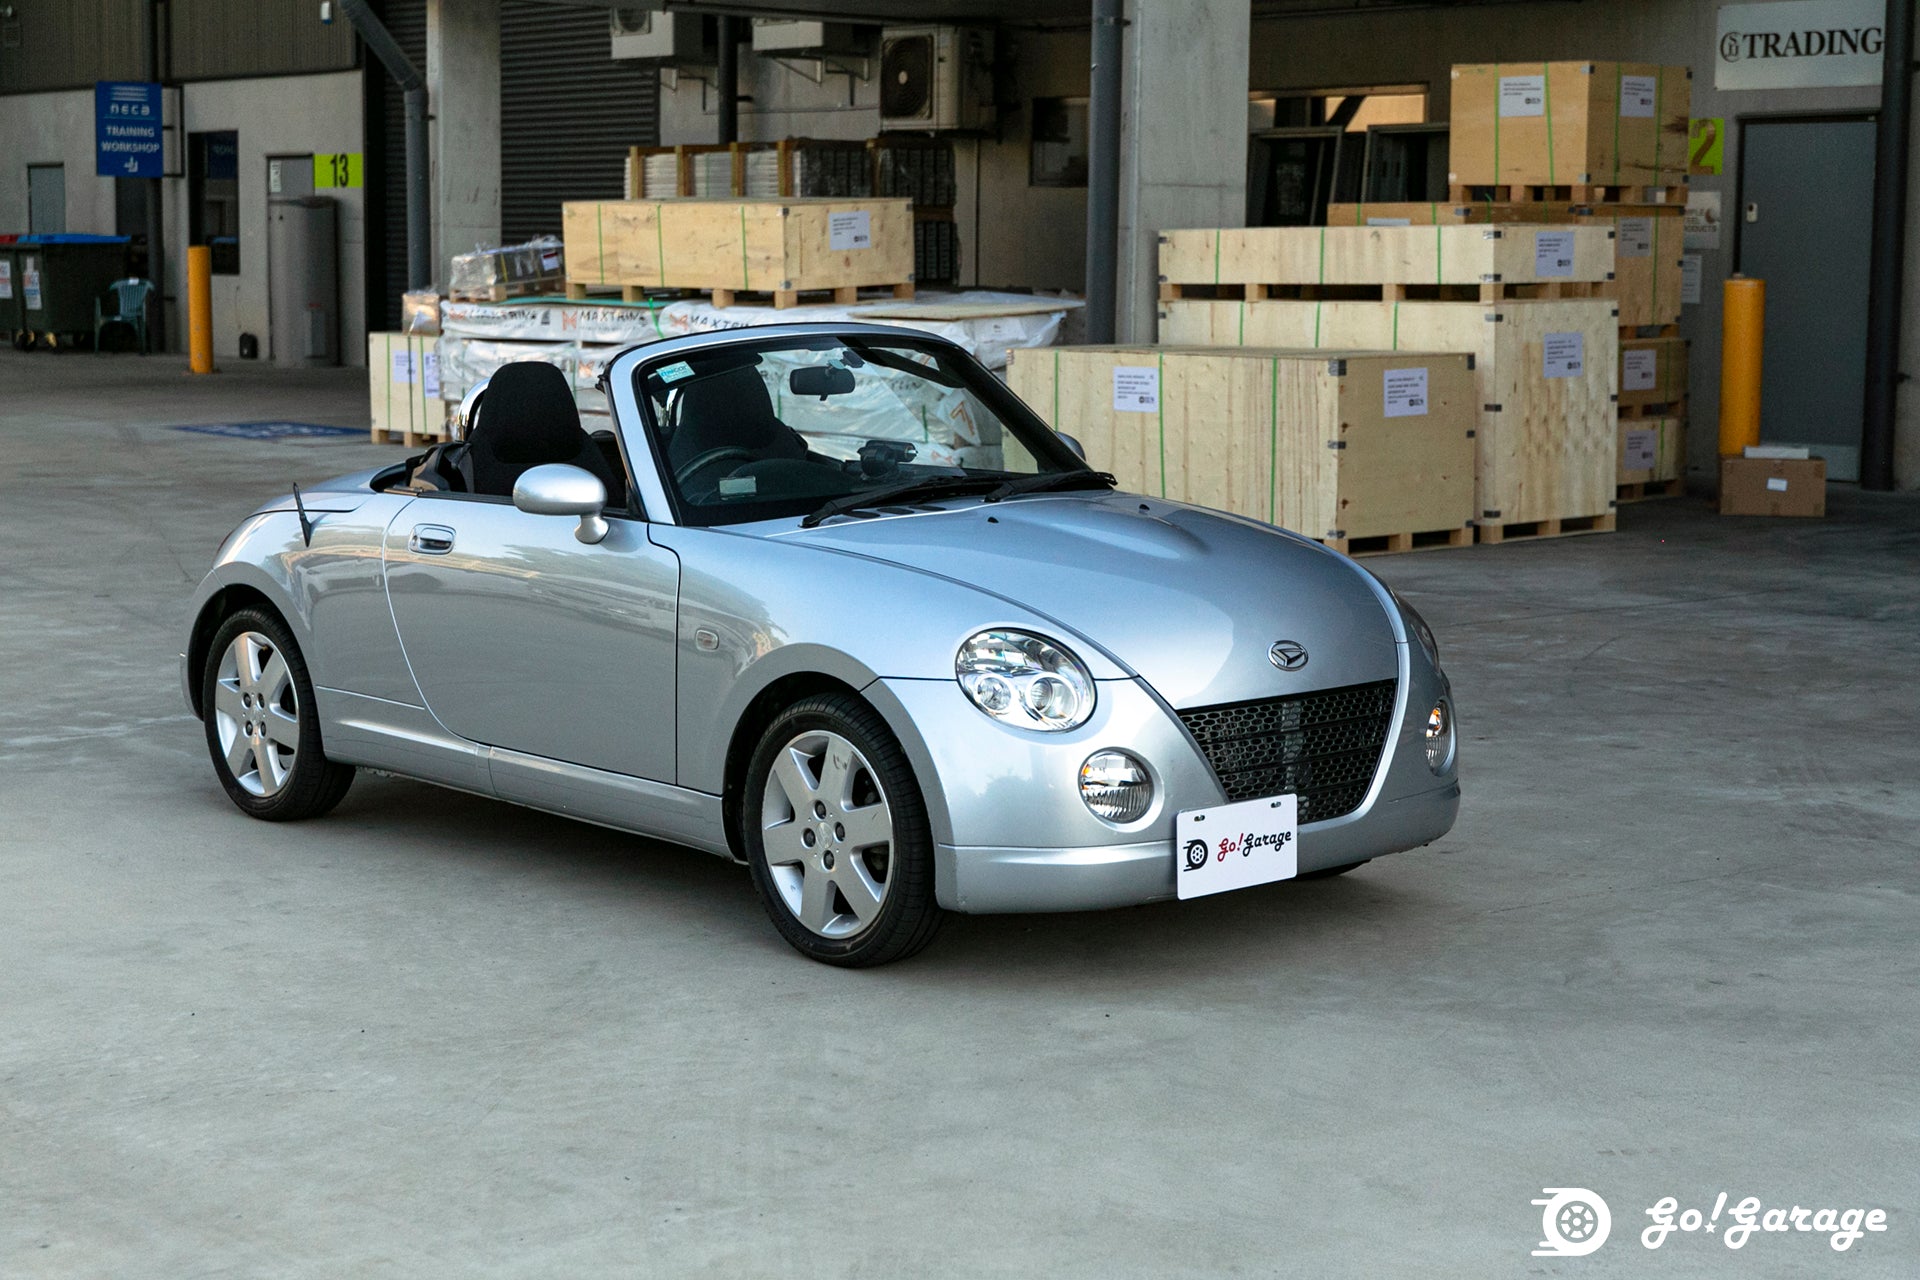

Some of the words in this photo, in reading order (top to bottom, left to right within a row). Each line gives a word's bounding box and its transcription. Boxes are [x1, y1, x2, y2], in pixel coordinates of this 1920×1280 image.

[1743, 27, 1883, 59] TRADING
[110, 103, 151, 116] neca
[106, 125, 156, 138] TRAINING
[101, 141, 160, 154] WORKSHOP
[1690, 119, 1716, 175] 2
[330, 153, 349, 188] 13
